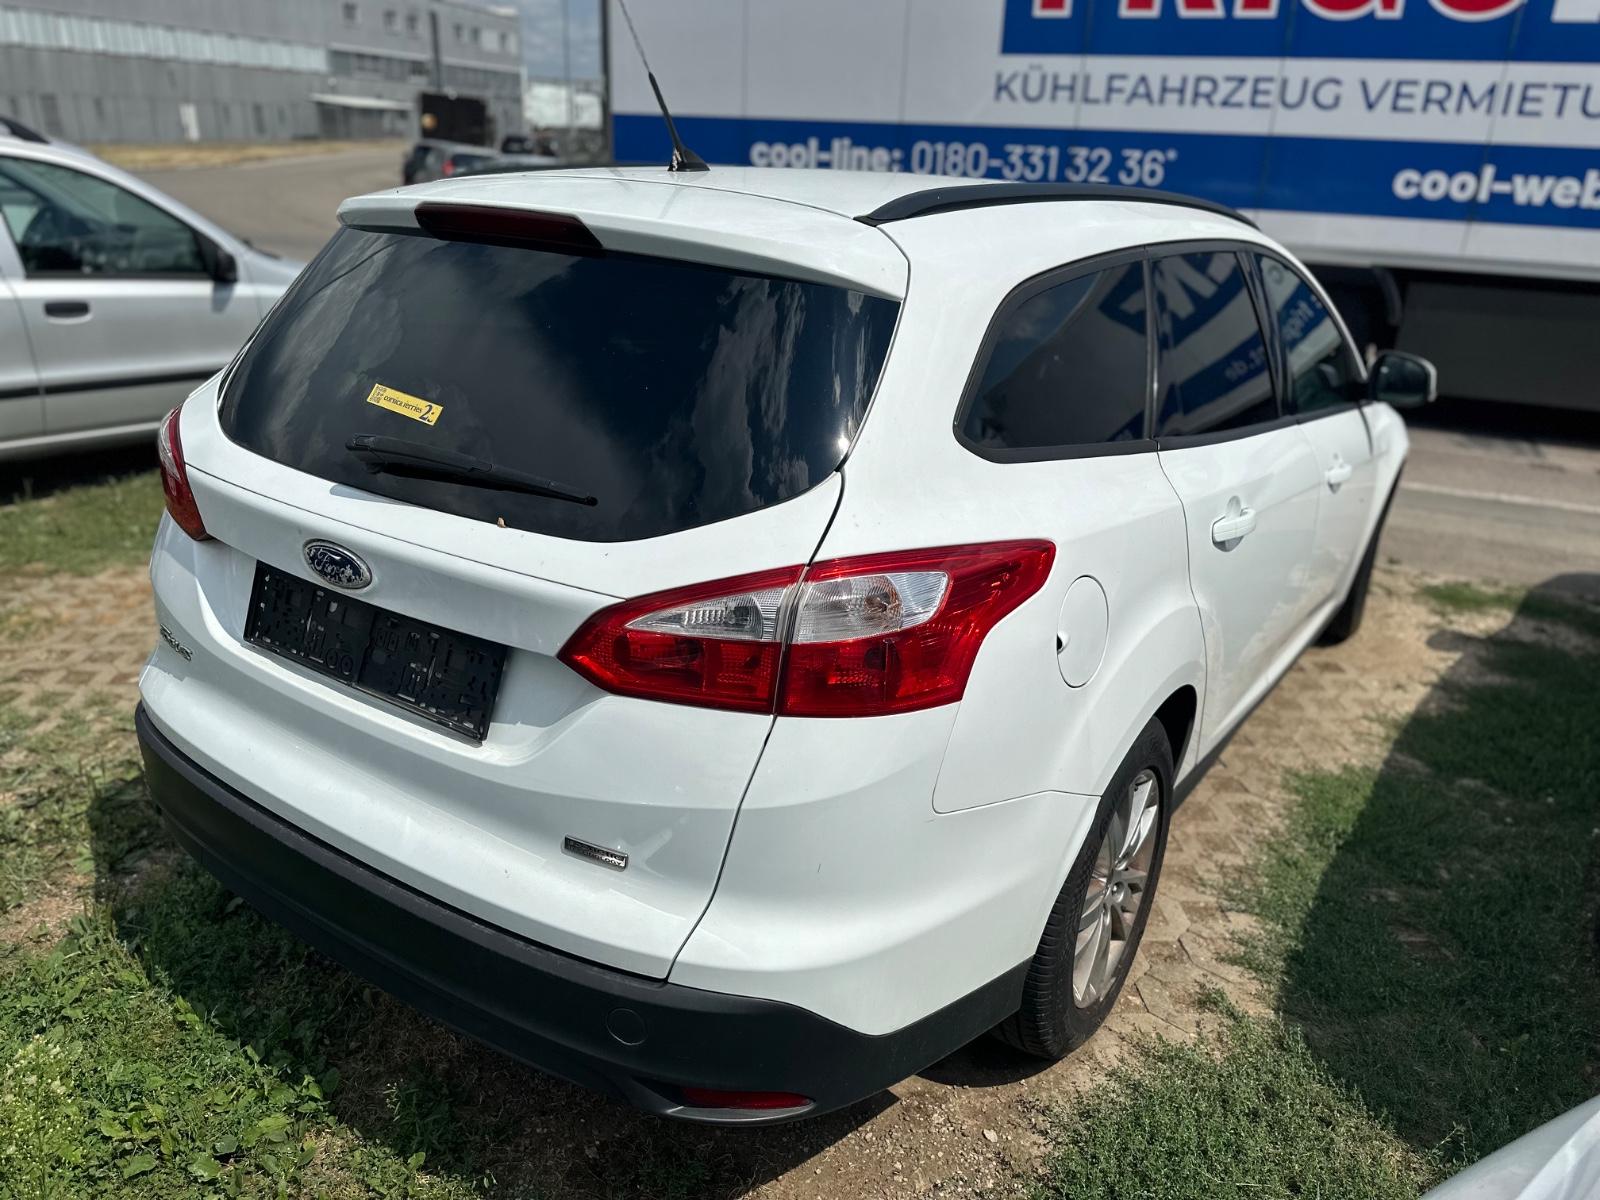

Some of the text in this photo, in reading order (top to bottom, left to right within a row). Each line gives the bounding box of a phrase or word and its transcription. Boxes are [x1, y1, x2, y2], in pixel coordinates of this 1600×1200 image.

[993, 63, 1343, 112] KÜHLFAHRZEUG
[750, 136, 905, 173] cool-line:
[911, 140, 1058, 181] 0180-331
[1065, 146, 1112, 184] 32
[1391, 163, 1600, 211] cool-web
